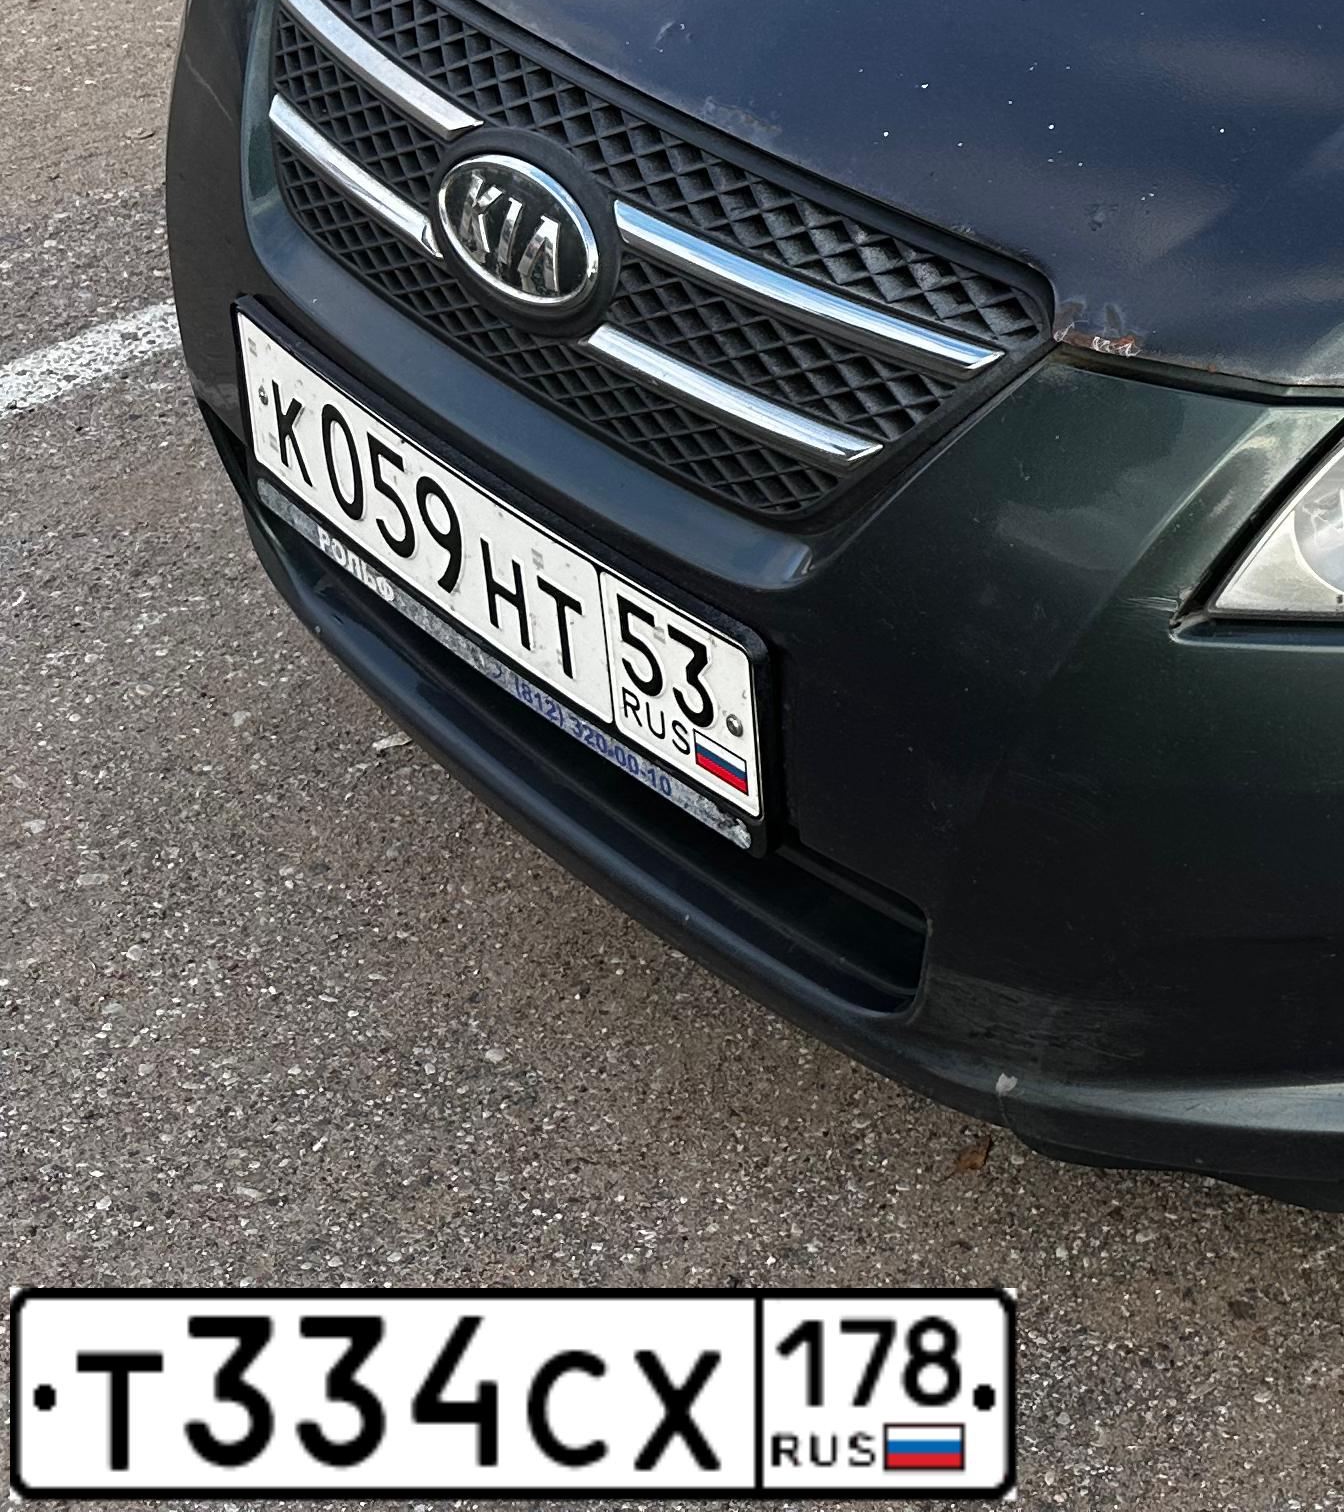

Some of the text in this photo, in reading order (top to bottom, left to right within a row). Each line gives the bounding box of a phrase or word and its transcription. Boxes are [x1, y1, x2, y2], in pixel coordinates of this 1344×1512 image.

[459, 178, 562, 295] KIA
[270, 377, 717, 728] К059НТ 53
[317, 524, 396, 603] РОЛЬФ
[514, 676, 565, 731] (812)
[621, 686, 692, 756] RUS
